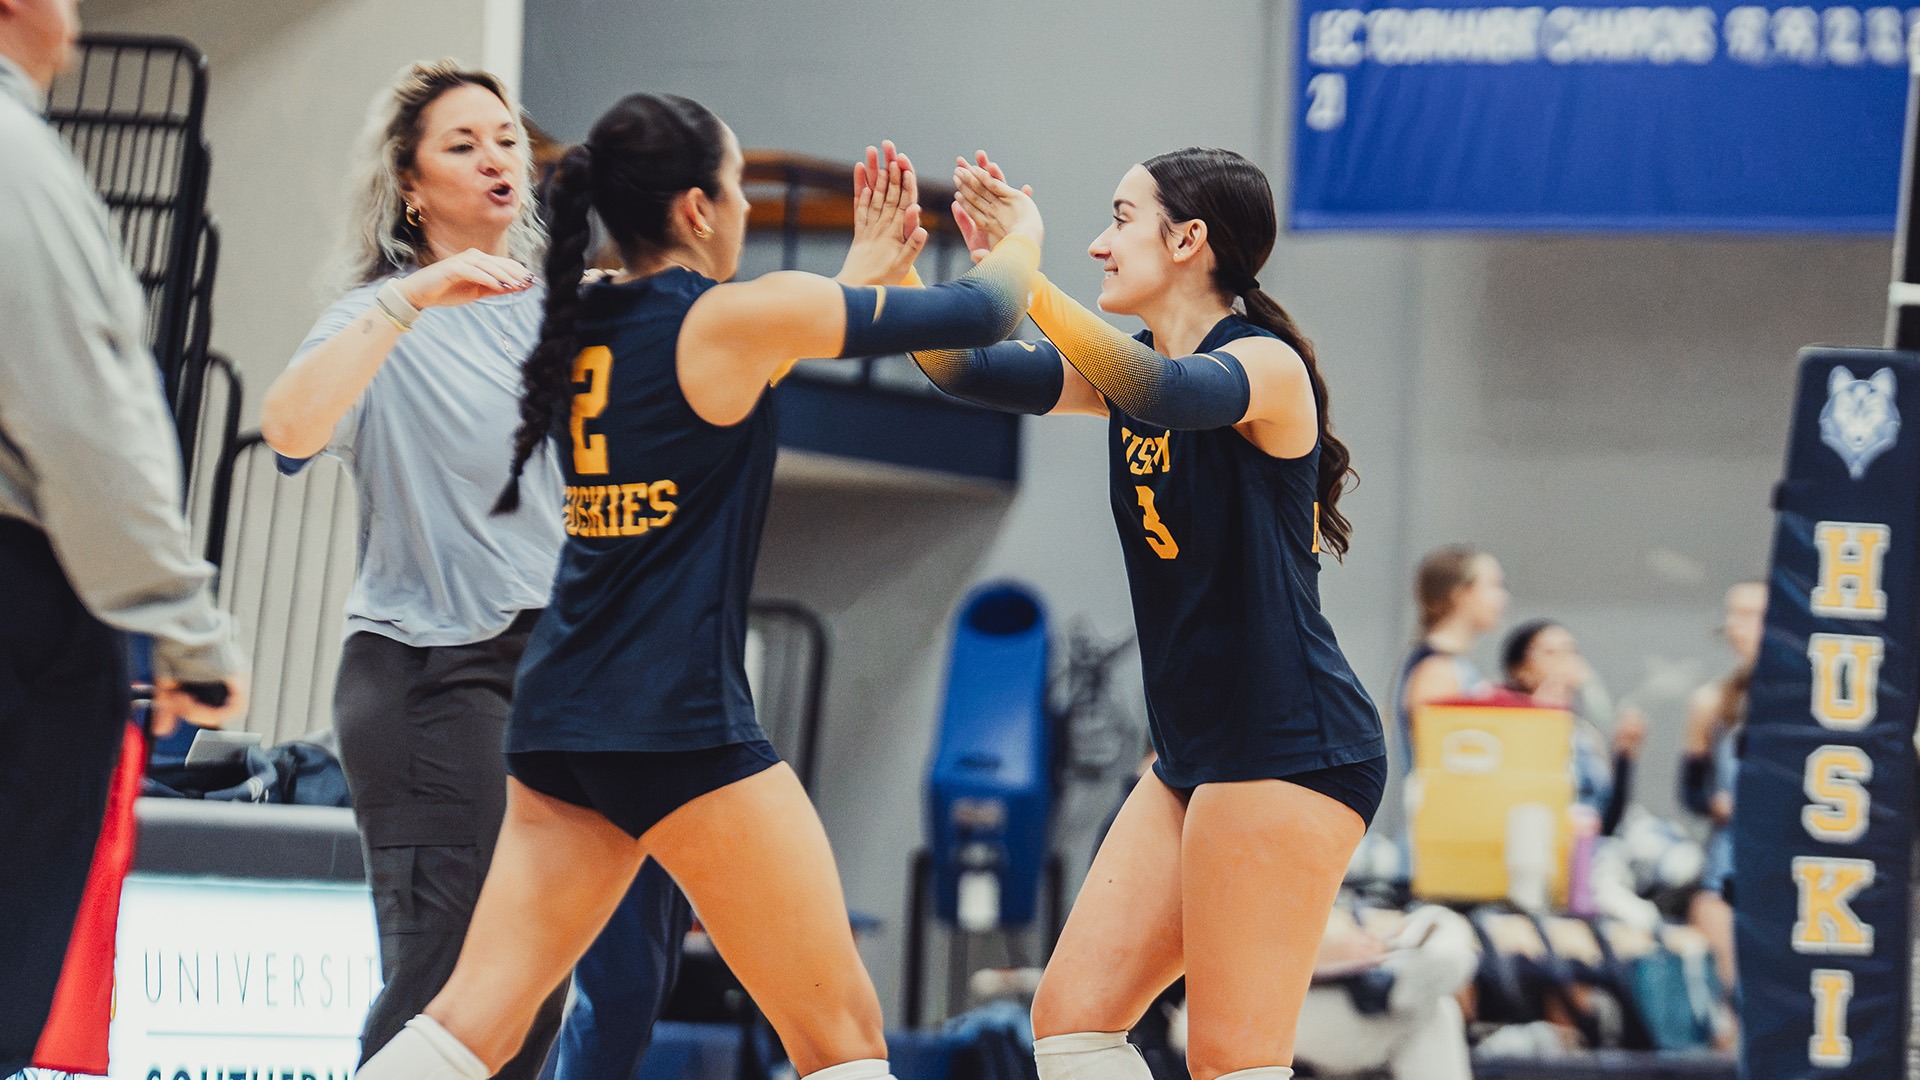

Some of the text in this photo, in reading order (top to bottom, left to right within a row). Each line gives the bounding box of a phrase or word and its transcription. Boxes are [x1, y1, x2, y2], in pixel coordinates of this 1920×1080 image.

[570, 345, 613, 475] 2
[561, 479, 678, 537] USKIES
[1134, 485, 1180, 560] 3
